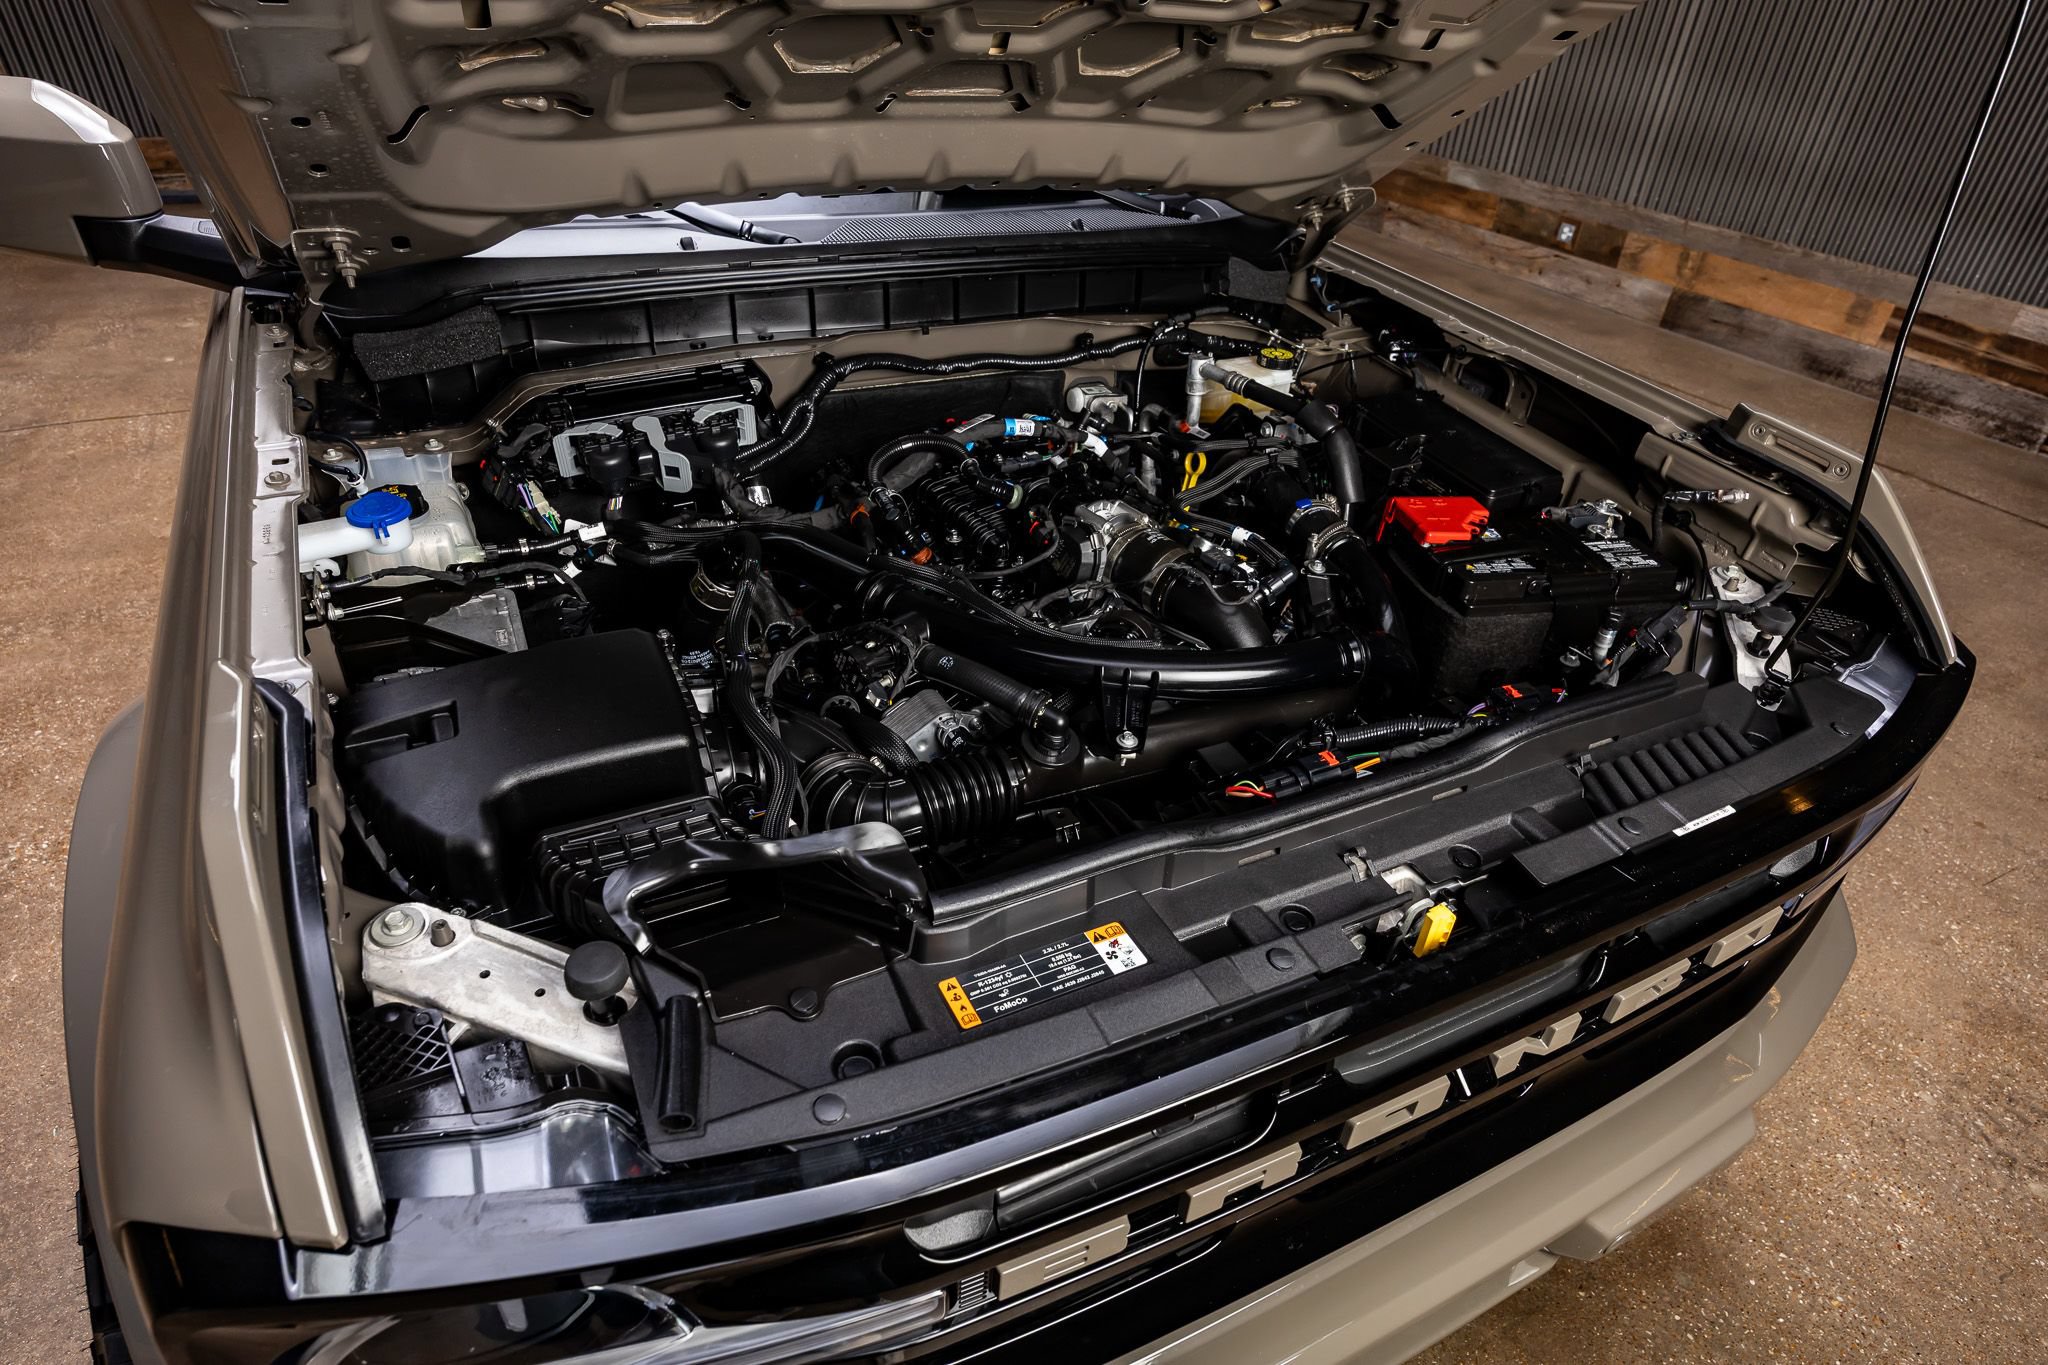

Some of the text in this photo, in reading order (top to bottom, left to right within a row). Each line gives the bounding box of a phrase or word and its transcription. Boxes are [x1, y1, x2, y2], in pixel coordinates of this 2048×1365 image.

[978, 975, 1004, 987] R-1234yf
[1052, 984, 1064, 992] SAE
[993, 997, 1028, 1013] FoMoCo
